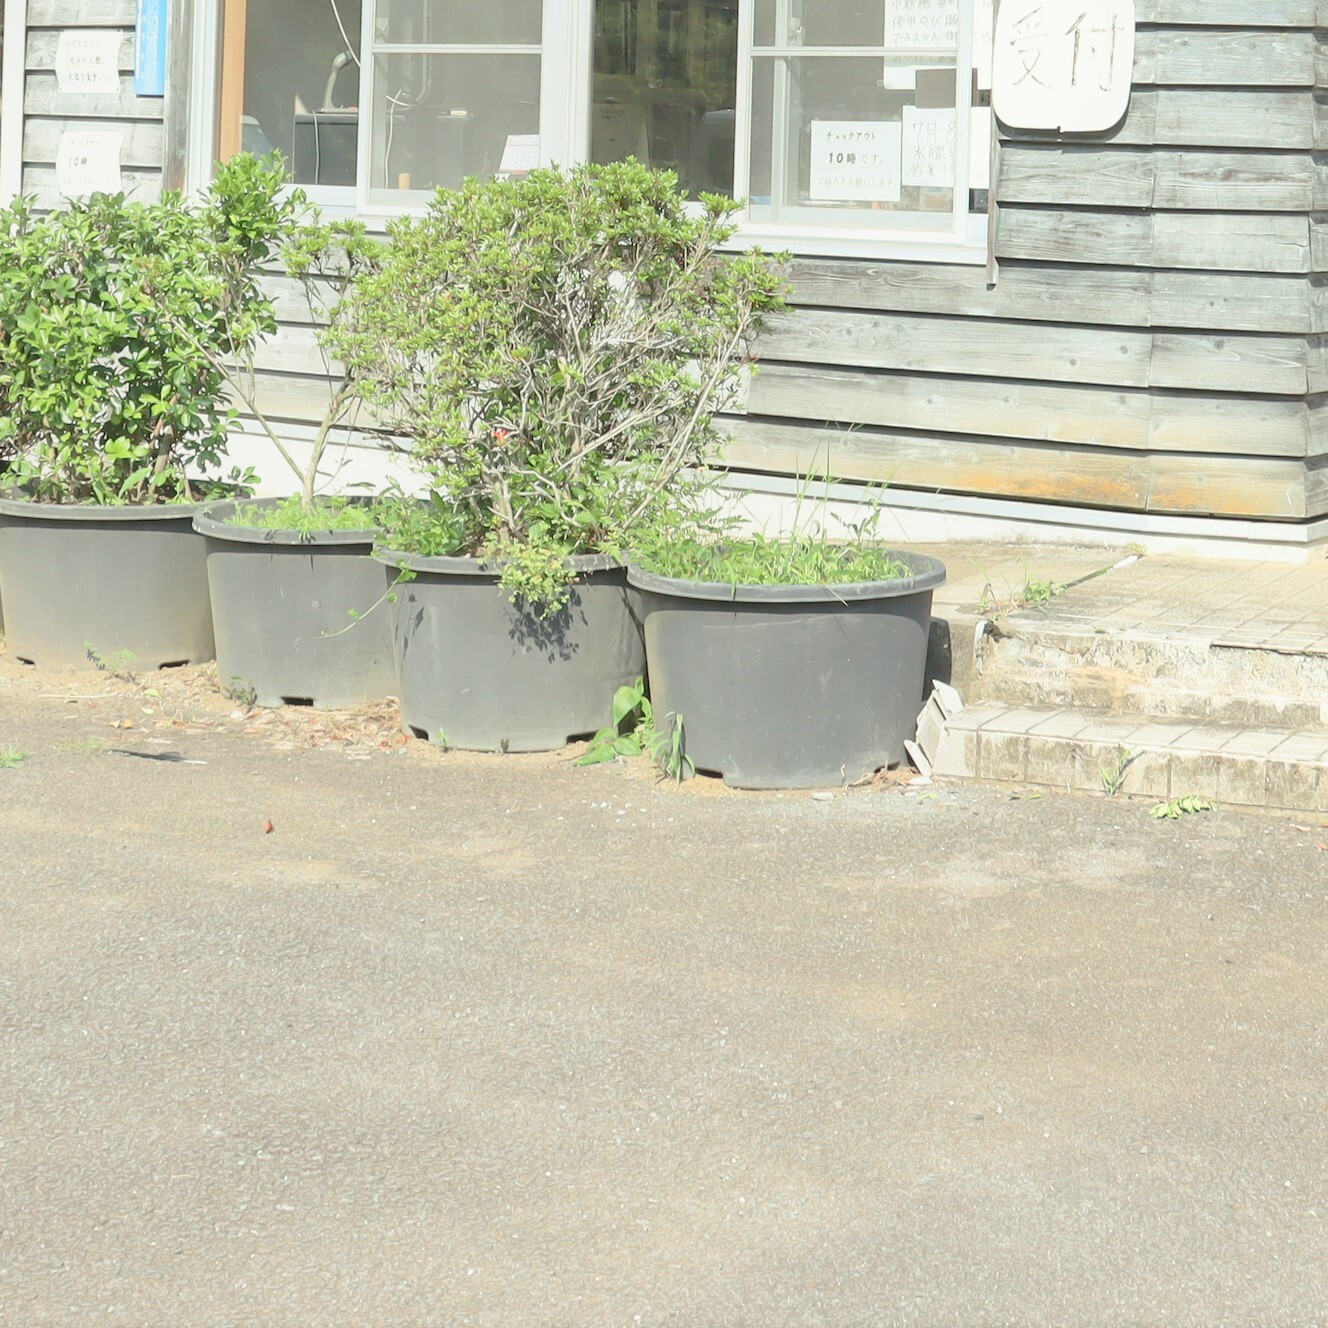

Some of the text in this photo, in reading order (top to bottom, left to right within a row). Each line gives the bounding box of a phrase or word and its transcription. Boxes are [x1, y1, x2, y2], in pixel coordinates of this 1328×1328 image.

[1009, 6, 1125, 92] 受付
[825, 131, 876, 141] チェックアウト
[913, 122, 937, 144] 7月
[828, 153, 883, 165] 10時です。
